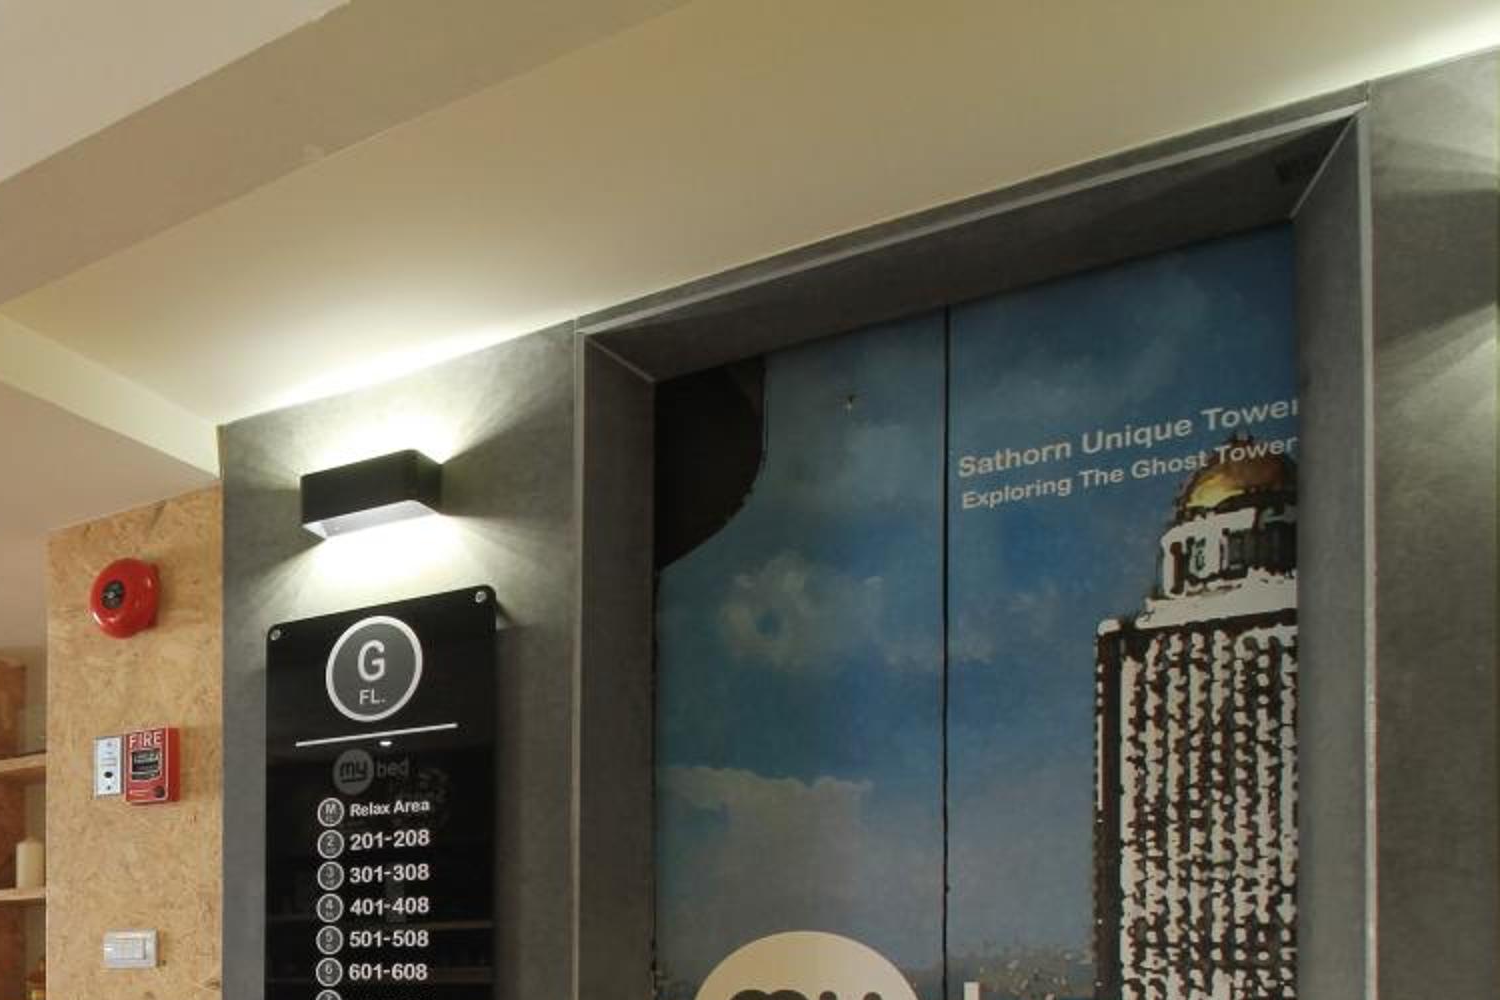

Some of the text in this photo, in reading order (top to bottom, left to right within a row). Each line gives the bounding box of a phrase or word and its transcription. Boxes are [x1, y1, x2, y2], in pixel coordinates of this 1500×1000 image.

[958, 440, 1072, 478] Sathorn
[1082, 417, 1192, 455] Unique
[962, 435, 1298, 509] Exploring The Ghost Tower
[358, 640, 385, 682] G
[359, 688, 386, 705] FL.
[129, 731, 163, 748] FIRE
[340, 757, 410, 784] my bed
[325, 799, 430, 817] M Relax Area
[349, 829, 430, 851] 201-208
[349, 863, 430, 883] 301-308
[349, 896, 429, 916] 401-408
[349, 929, 429, 948] 501-508
[348, 962, 428, 981] 601-608
